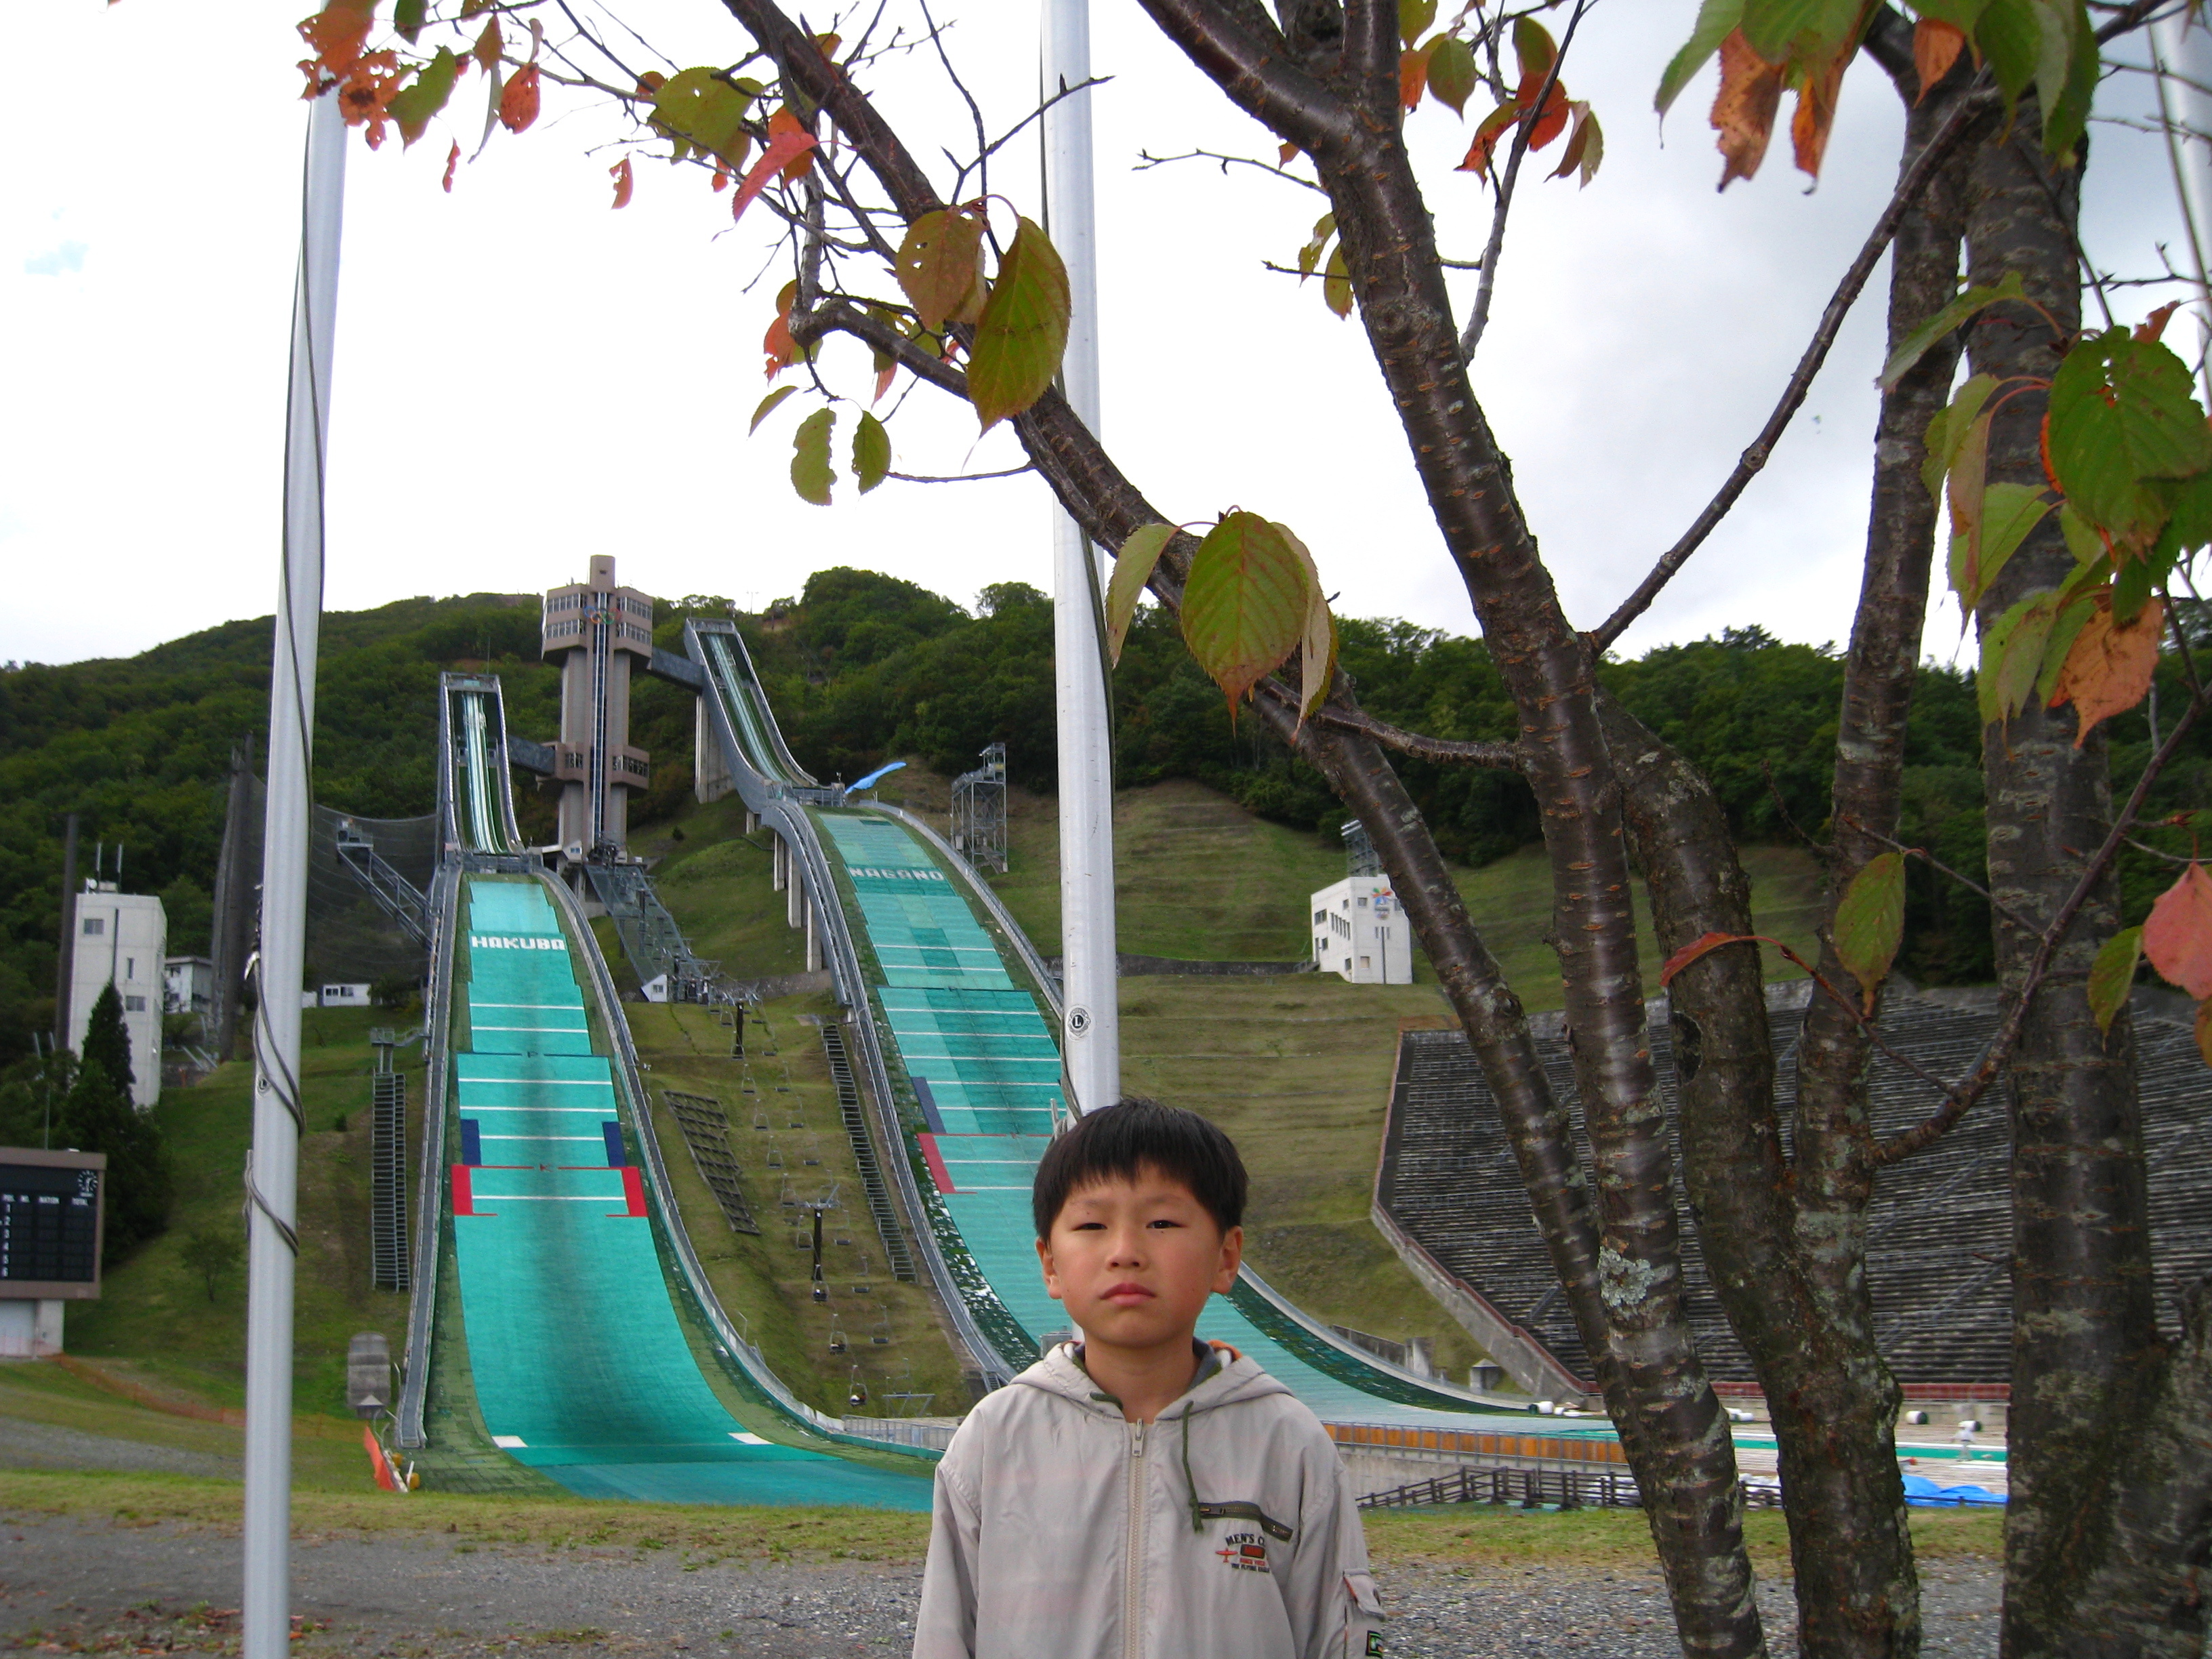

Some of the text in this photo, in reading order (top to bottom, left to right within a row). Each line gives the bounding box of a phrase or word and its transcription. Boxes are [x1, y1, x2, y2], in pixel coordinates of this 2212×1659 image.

[848, 867, 945, 881] NAGANO
[471, 936, 566, 950] HAKUBA
[1075, 1016, 1082, 1027] L
[4, 1216, 11, 1226] 2
[3, 1229, 10, 1239] 3
[1225, 1533, 1254, 1546] MEN'S
